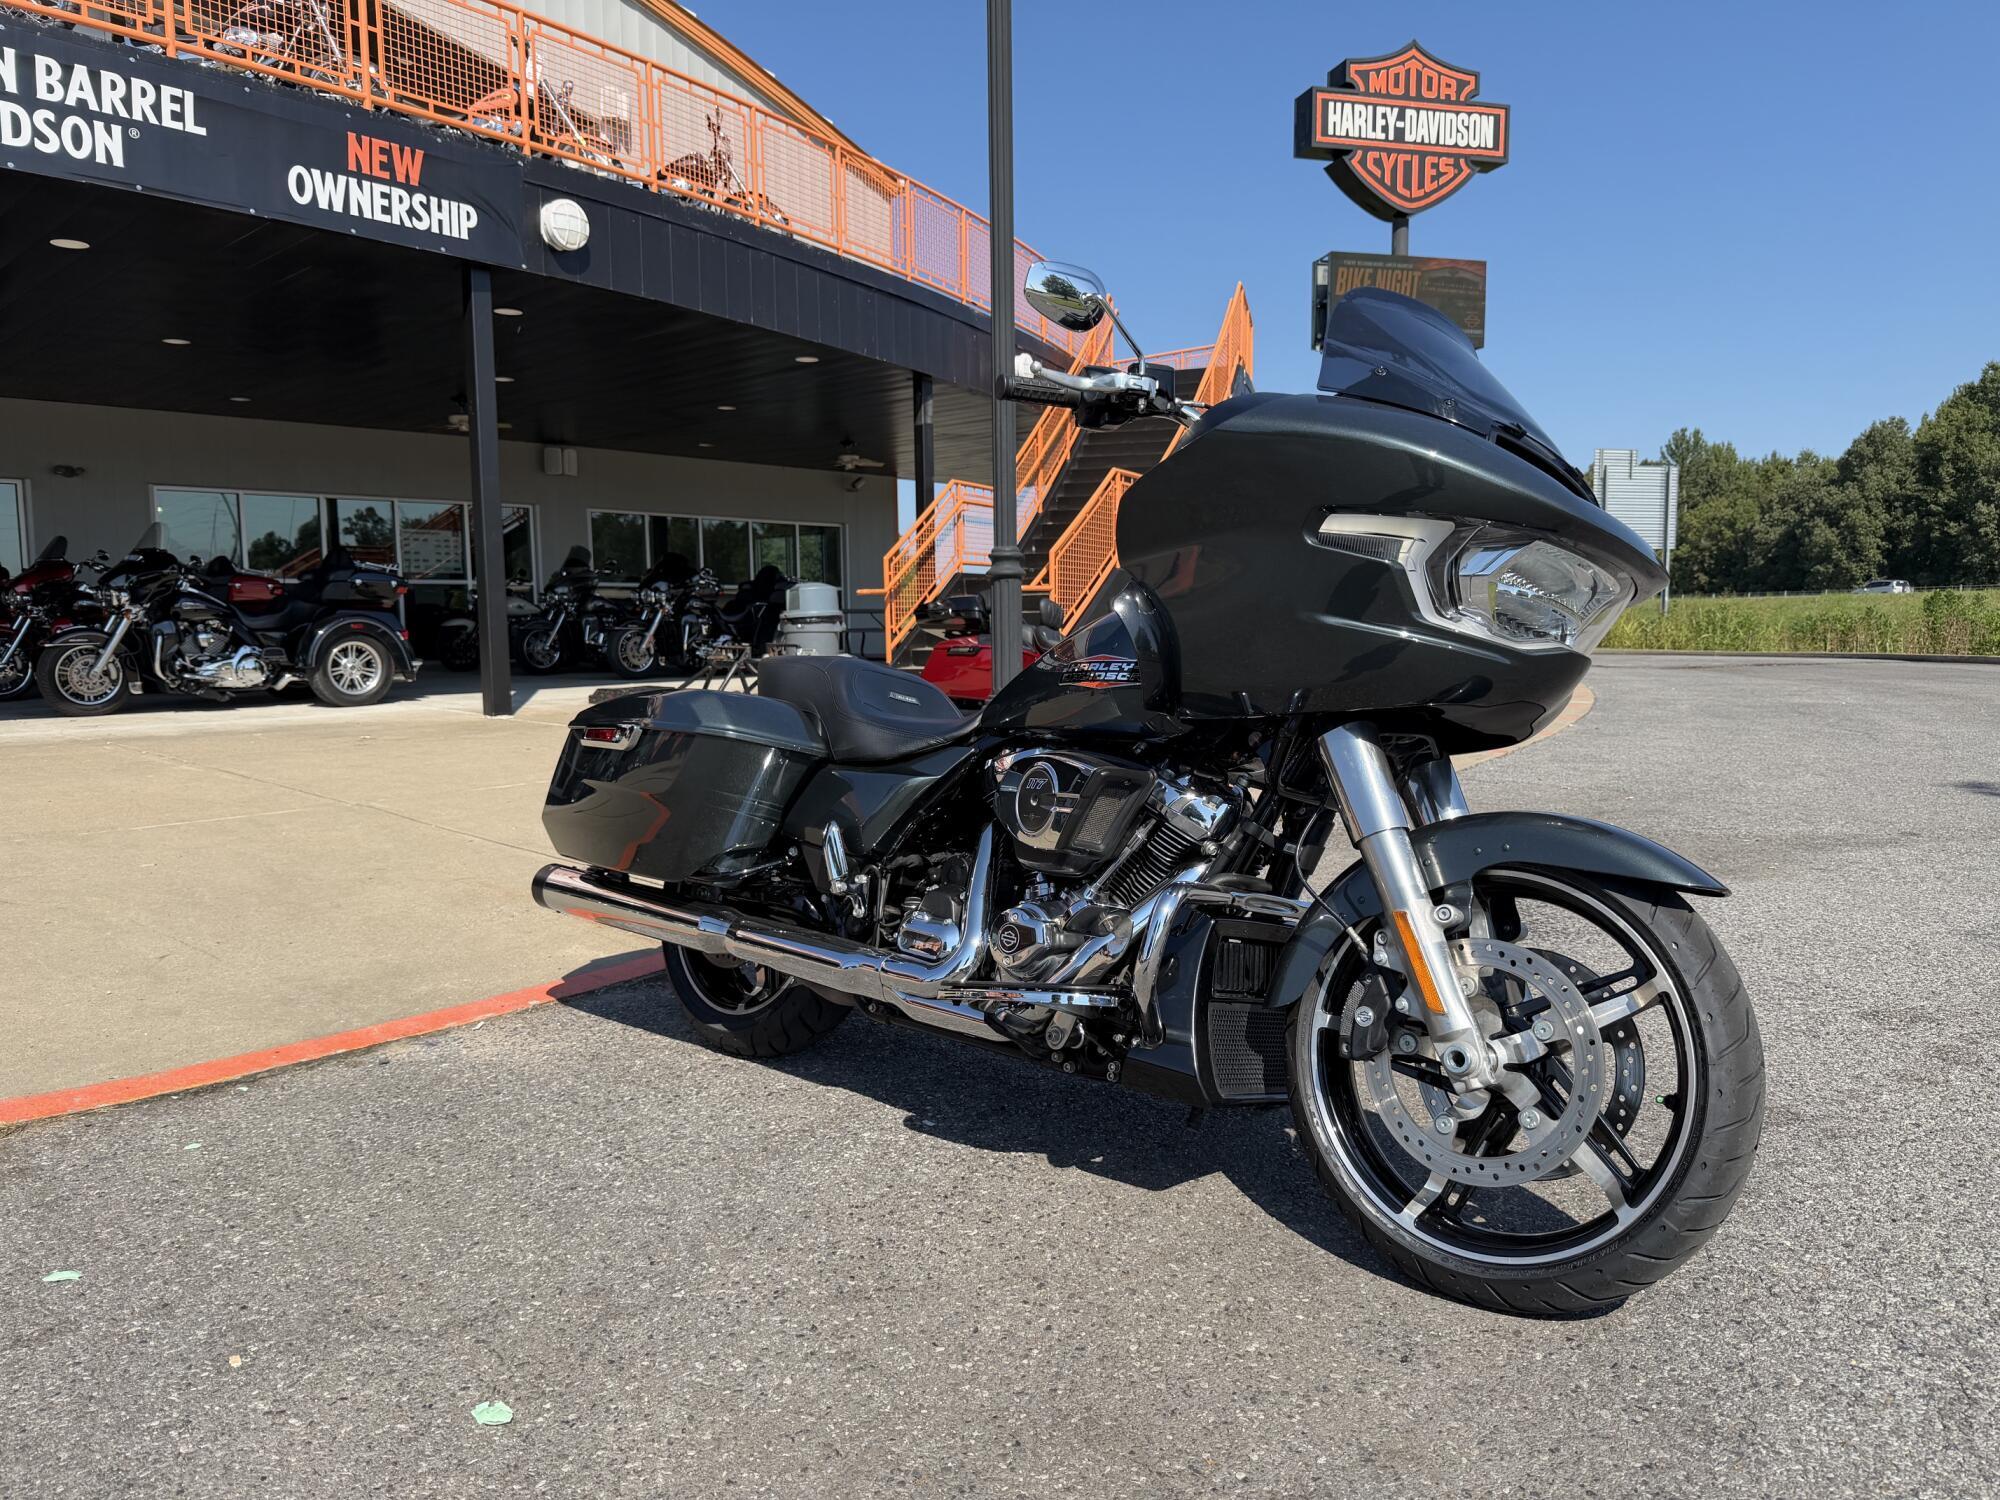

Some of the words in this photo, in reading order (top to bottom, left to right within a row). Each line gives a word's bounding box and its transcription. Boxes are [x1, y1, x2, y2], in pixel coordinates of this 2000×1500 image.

[34, 54, 207, 136] BARREL
[1369, 58, 1457, 101] MOTOR
[1327, 101, 1494, 148] HARLEY-DAVIDSON
[347, 131, 425, 187] NEW
[1366, 151, 1455, 198] CYCLES
[287, 164, 478, 240] OWNERSHIP
[1335, 267, 1373, 296] BIKE
[1375, 269, 1422, 299] NIGHT
[1026, 777, 1049, 790] 117
